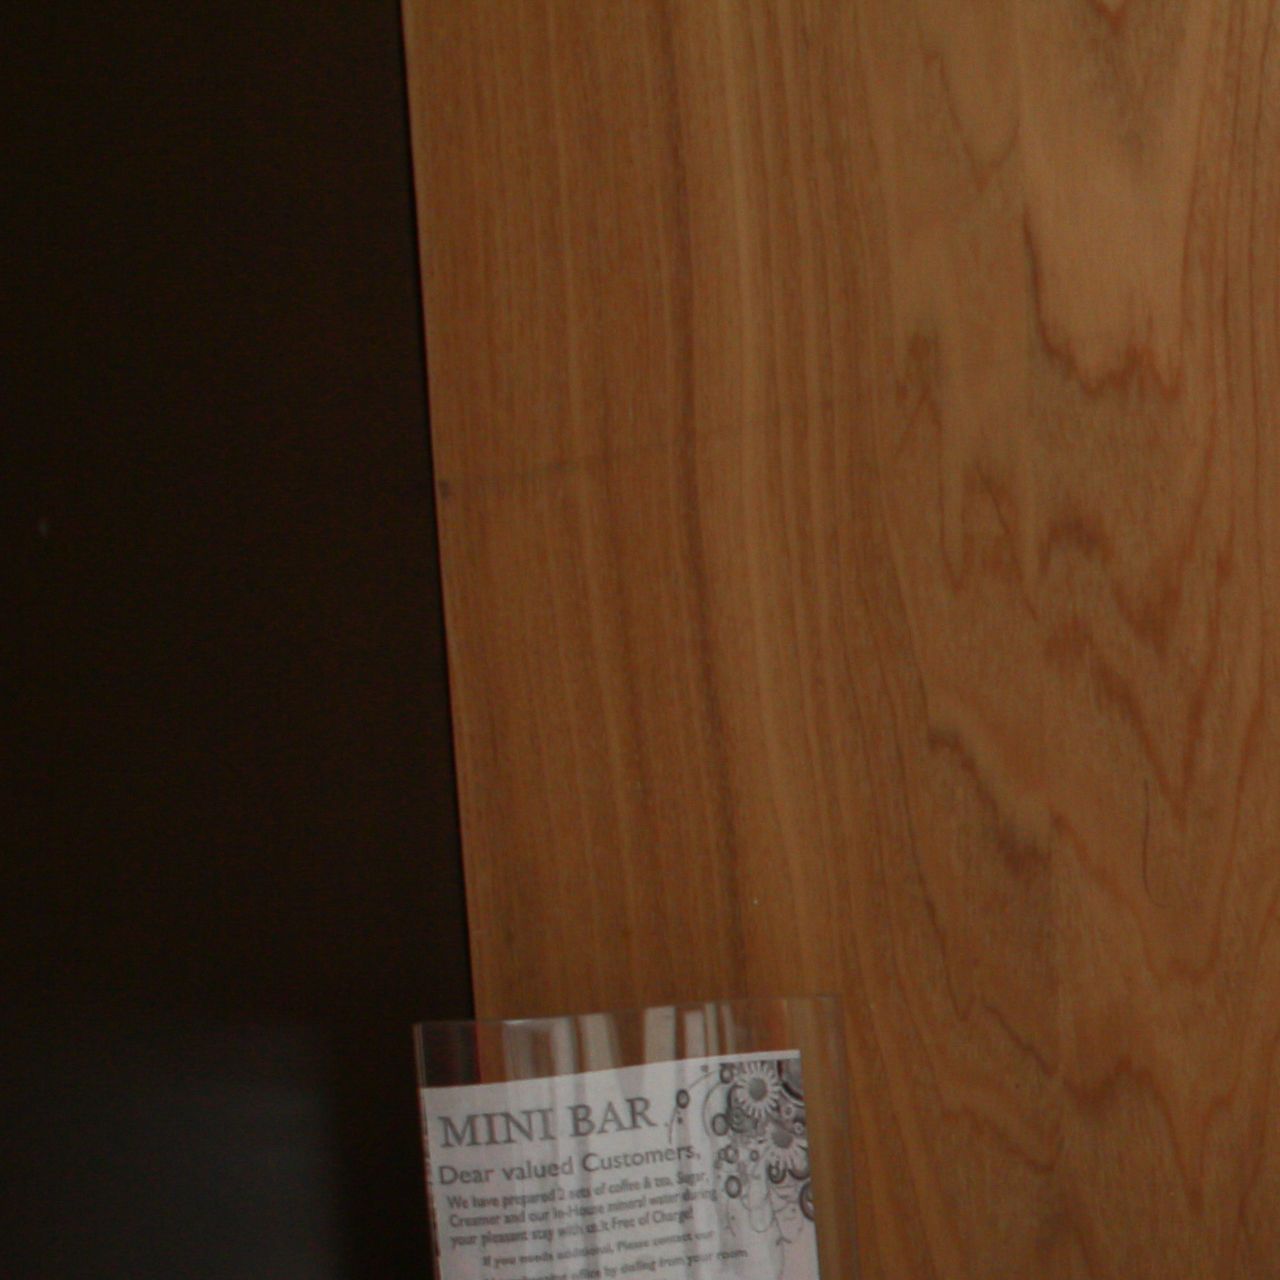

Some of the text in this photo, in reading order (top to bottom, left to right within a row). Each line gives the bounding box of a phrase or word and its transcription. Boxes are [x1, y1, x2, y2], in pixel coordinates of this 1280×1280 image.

[438, 1096, 657, 1147] MINI BAR
[439, 1146, 701, 1185] Dear valued Customers,
[593, 1182, 606, 1196] of
[449, 1235, 478, 1250] your
[638, 1211, 650, 1226] of
[504, 1208, 526, 1224] and
[528, 1211, 550, 1222] our
